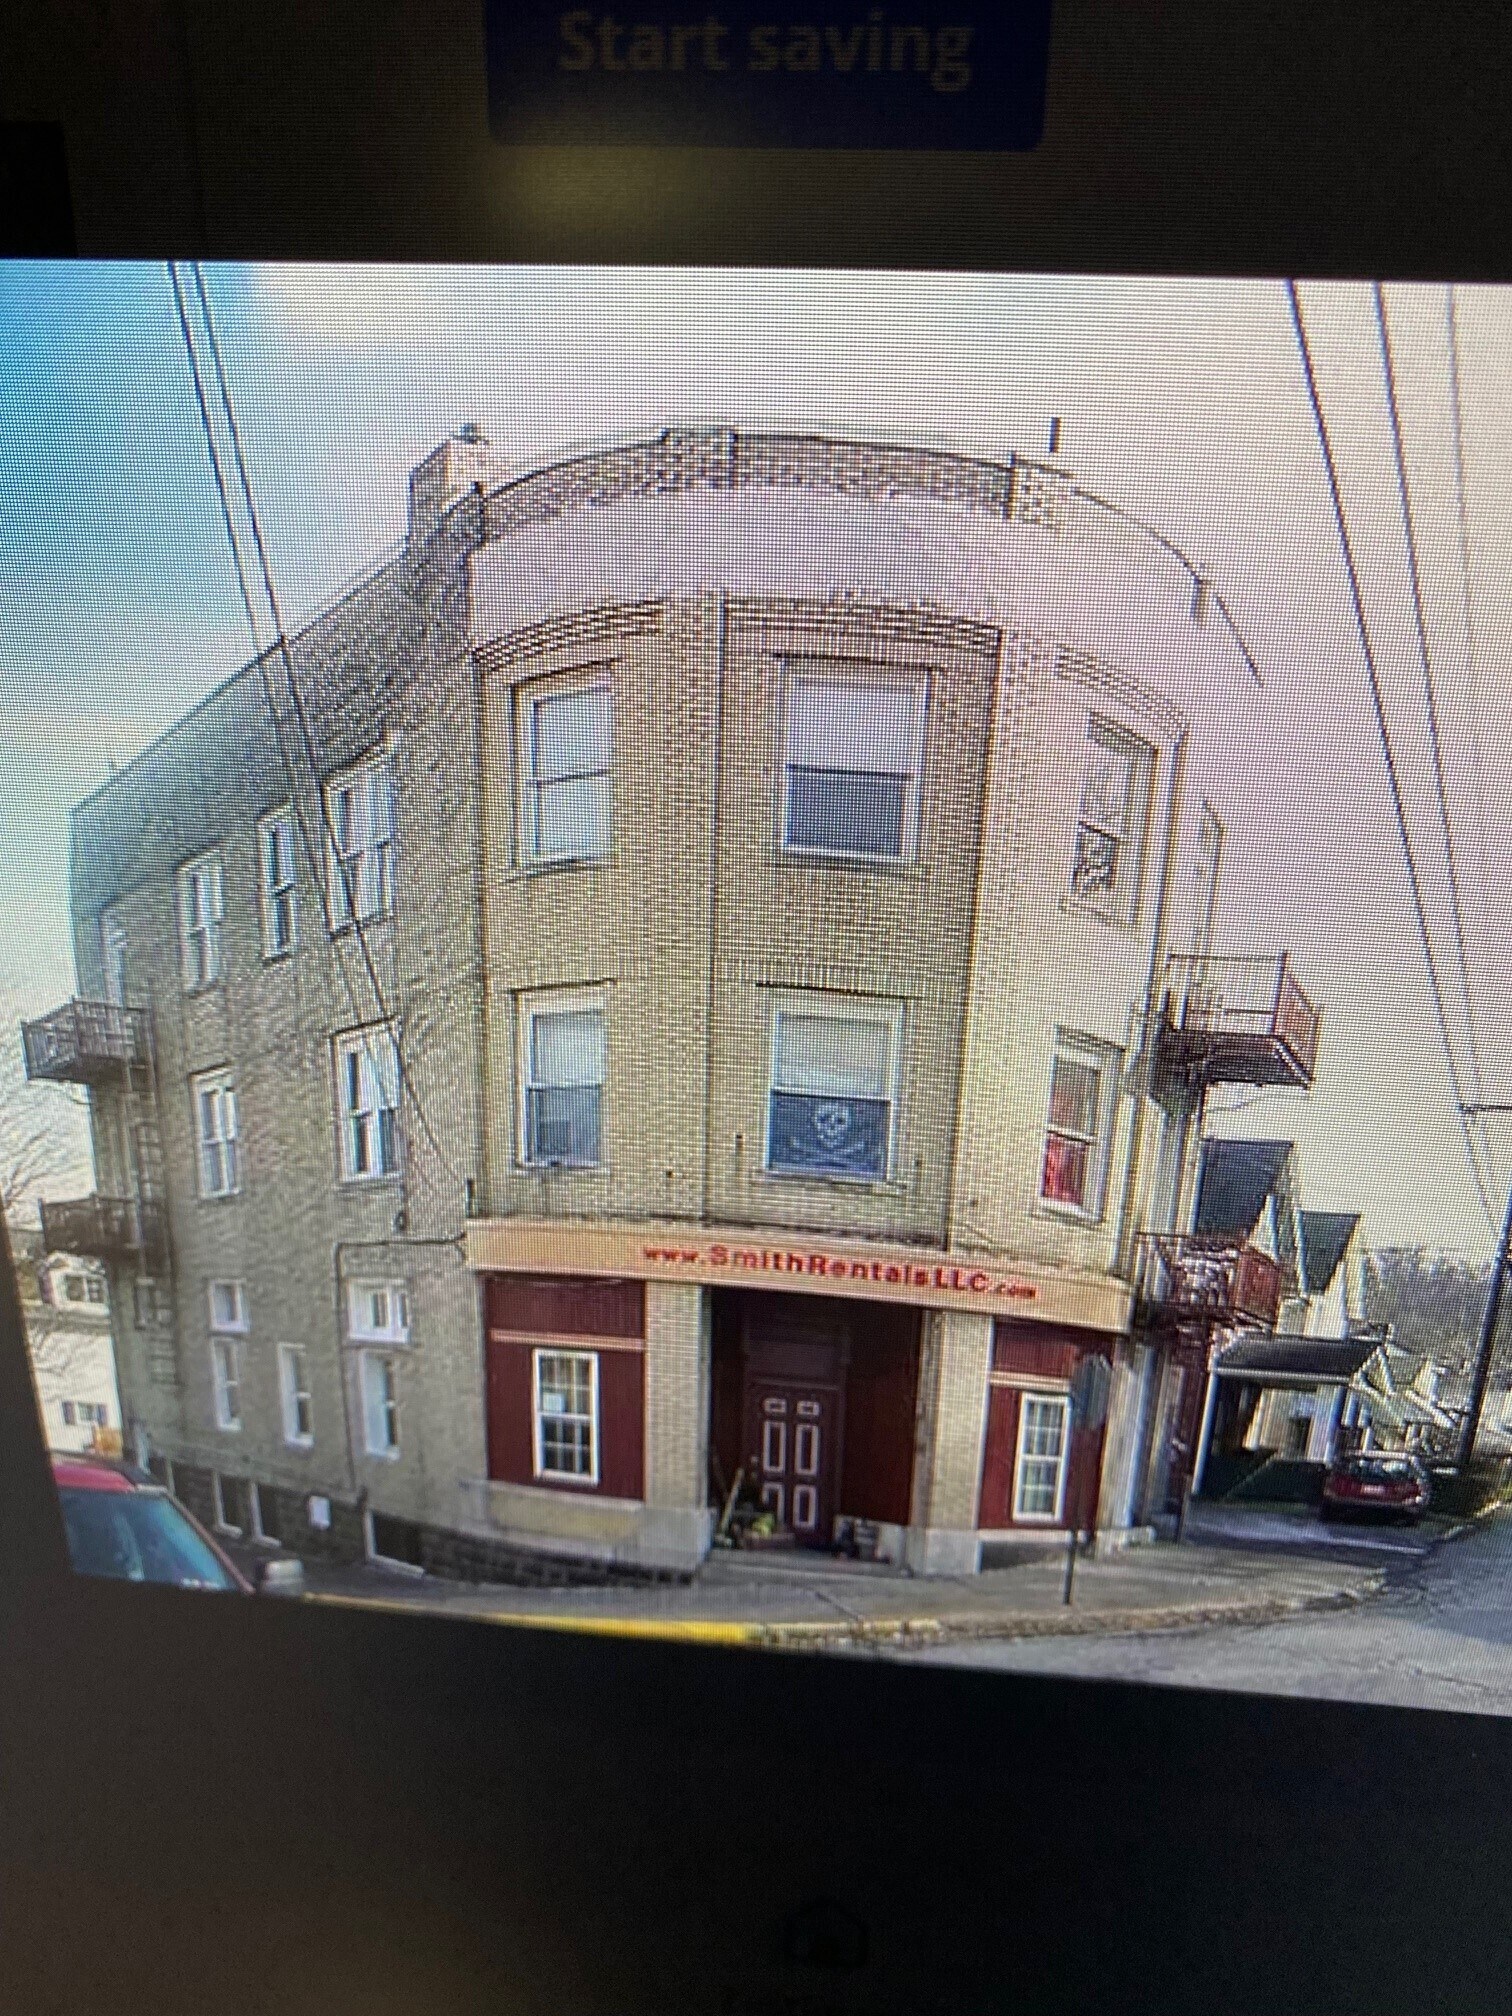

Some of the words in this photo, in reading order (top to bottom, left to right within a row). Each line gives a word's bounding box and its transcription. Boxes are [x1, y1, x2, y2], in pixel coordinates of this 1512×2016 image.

[559, 10, 729, 72] Start
[746, 8, 969, 92] saving
[643, 1243, 1037, 1299] www.SmithRentalsLLC.com
